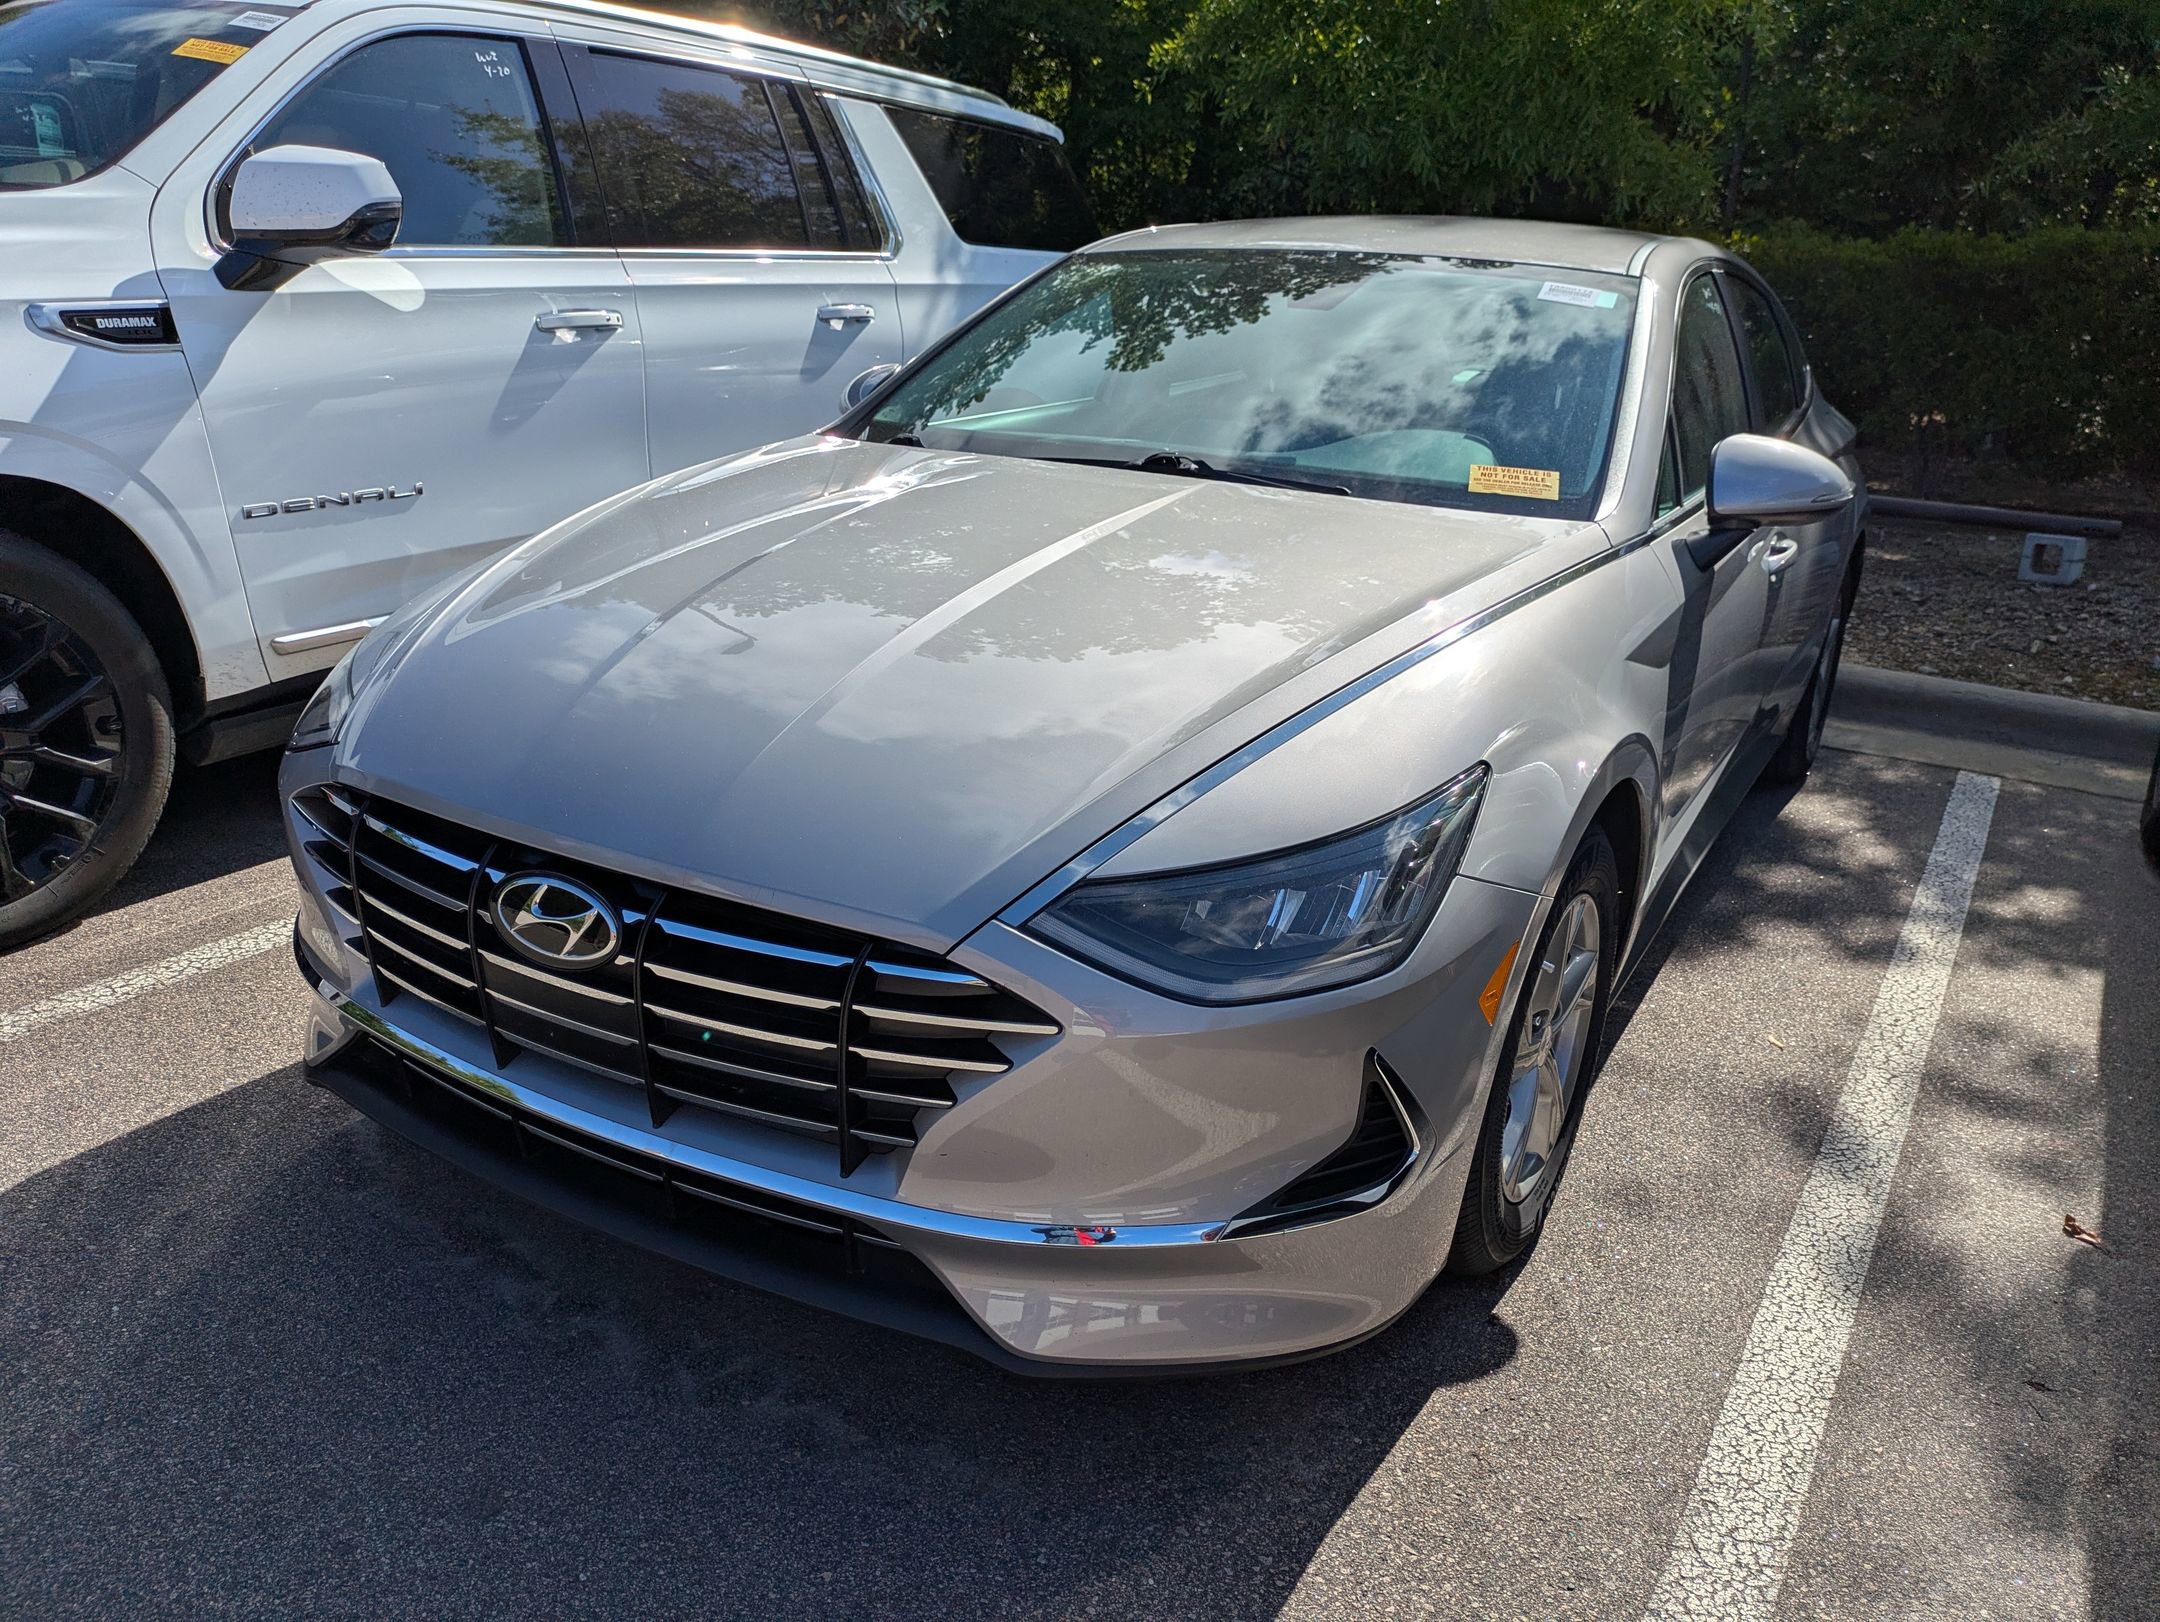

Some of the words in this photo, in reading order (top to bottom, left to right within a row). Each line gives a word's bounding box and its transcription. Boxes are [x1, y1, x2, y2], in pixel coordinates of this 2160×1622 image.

[95, 316, 157, 329] DURAMAX
[1476, 465, 1498, 473] THIS
[1501, 467, 1539, 477] VEHICLE
[1523, 475, 1547, 483] SALE
[241, 481, 424, 520] DENALI
